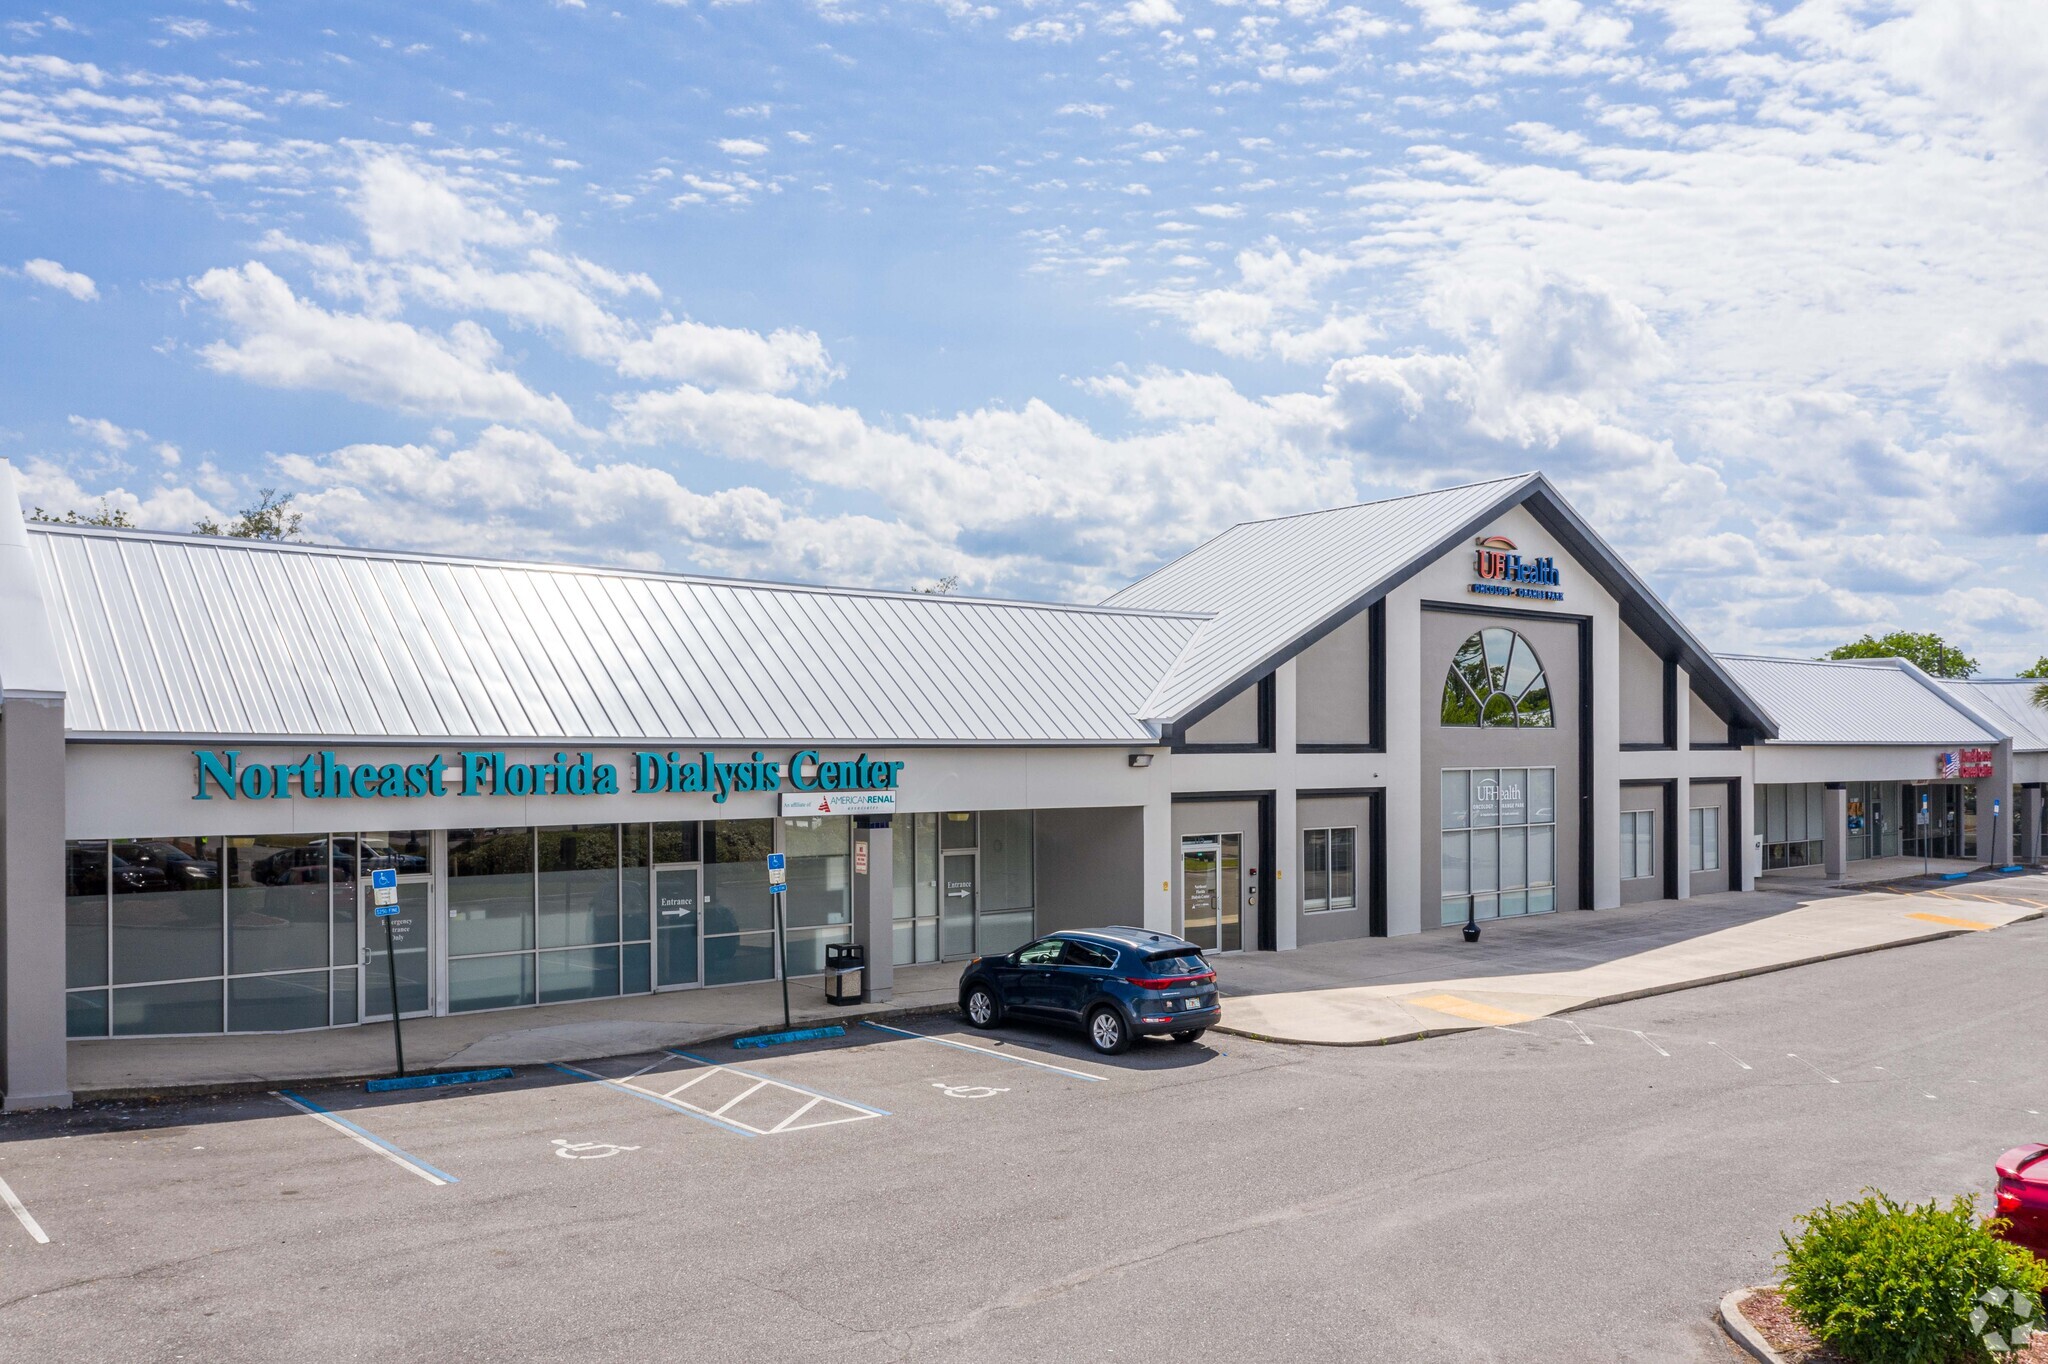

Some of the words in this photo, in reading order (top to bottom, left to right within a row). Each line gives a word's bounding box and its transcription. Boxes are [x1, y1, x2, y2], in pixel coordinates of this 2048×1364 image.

[1547, 592, 1564, 601] PARK
[192, 750, 448, 800] Northeast
[458, 751, 620, 796] Florida
[632, 751, 781, 804] Dialysis
[789, 750, 904, 791] Center
[947, 881, 971, 889] Entrance
[661, 898, 692, 906] Entrance
